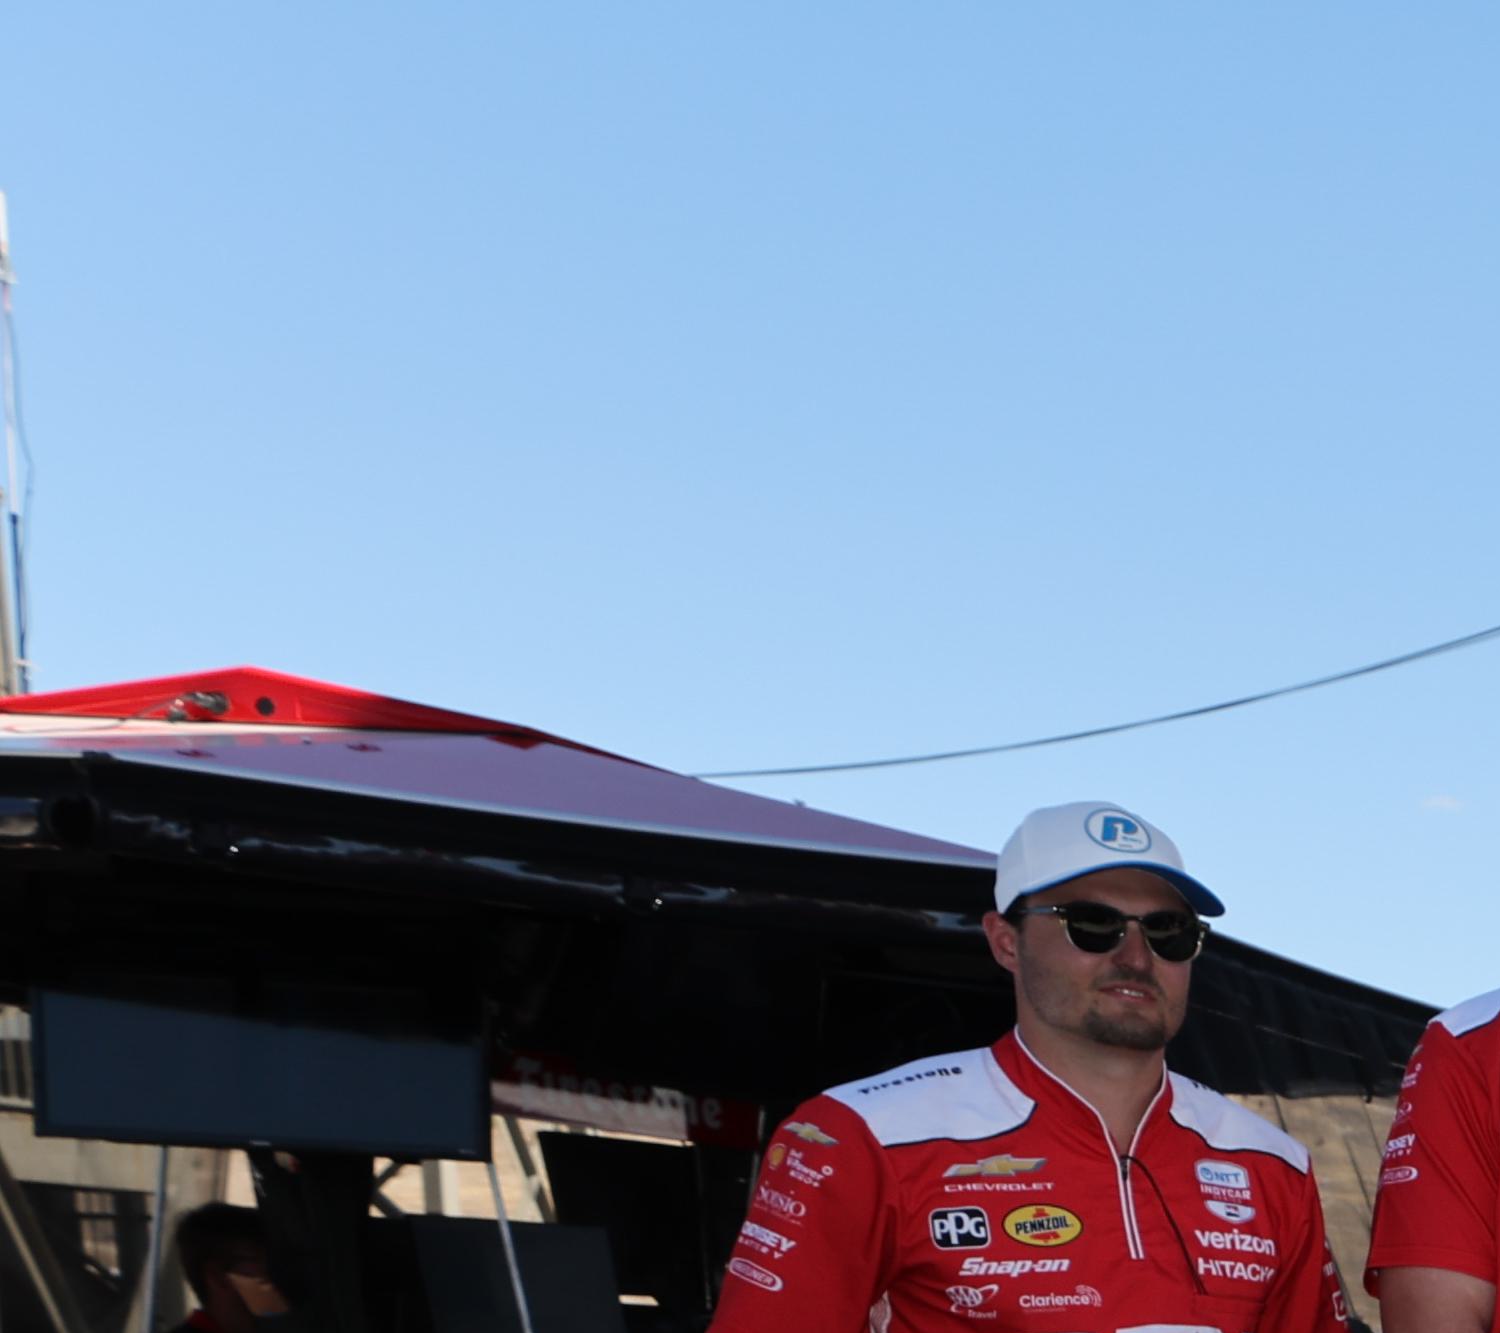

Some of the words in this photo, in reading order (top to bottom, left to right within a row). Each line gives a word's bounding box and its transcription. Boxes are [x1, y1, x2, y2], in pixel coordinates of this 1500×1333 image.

[944, 1181, 1054, 1193] CHEVROLET
[1199, 1184, 1251, 1200] INDYCAR
[932, 1210, 987, 1245] PPG
[1015, 1216, 1072, 1235] PENNZOIL
[1194, 1228, 1275, 1257] verizon
[959, 1257, 1071, 1278] Snap-on
[1019, 1292, 1091, 1309] Clarience
